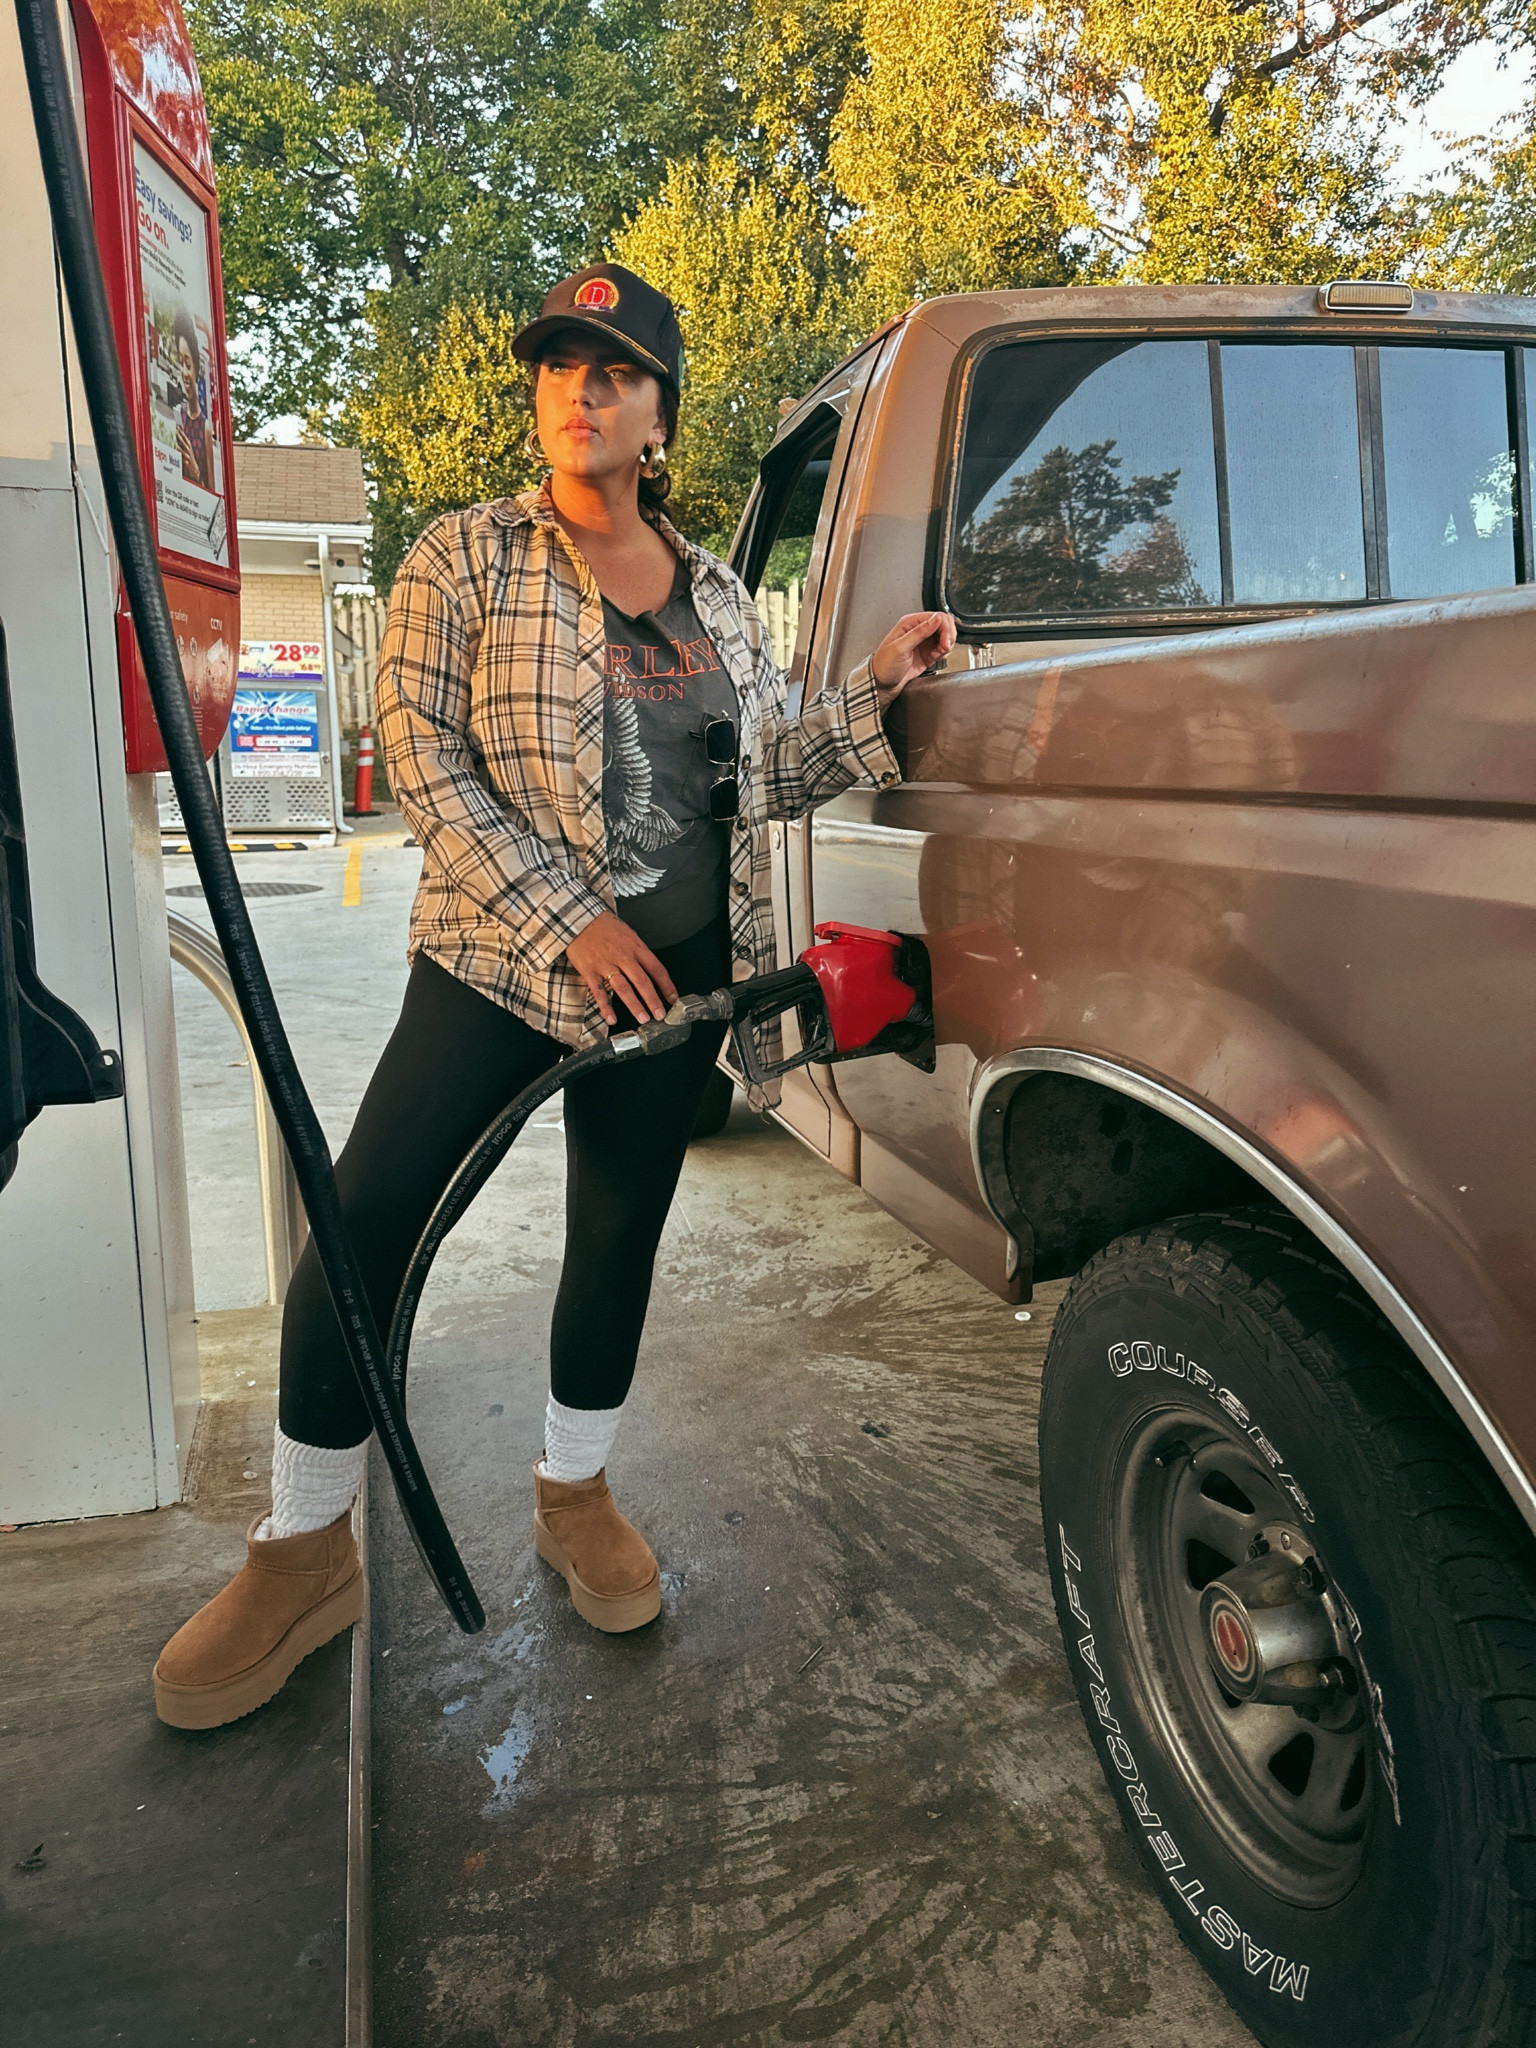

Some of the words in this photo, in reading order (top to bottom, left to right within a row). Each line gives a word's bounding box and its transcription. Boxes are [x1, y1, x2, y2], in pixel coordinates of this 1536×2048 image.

[136, 168, 156, 213] Easy
[158, 197, 193, 244] savings?
[137, 200, 152, 233] Go
[153, 222, 169, 250] on.
[589, 286, 606, 305] D
[174, 608, 189, 625] safety
[210, 617, 223, 631] CCTV
[1108, 1341, 1316, 1523] COURSER
[1059, 1523, 1309, 2001] MASTERCRAFT
